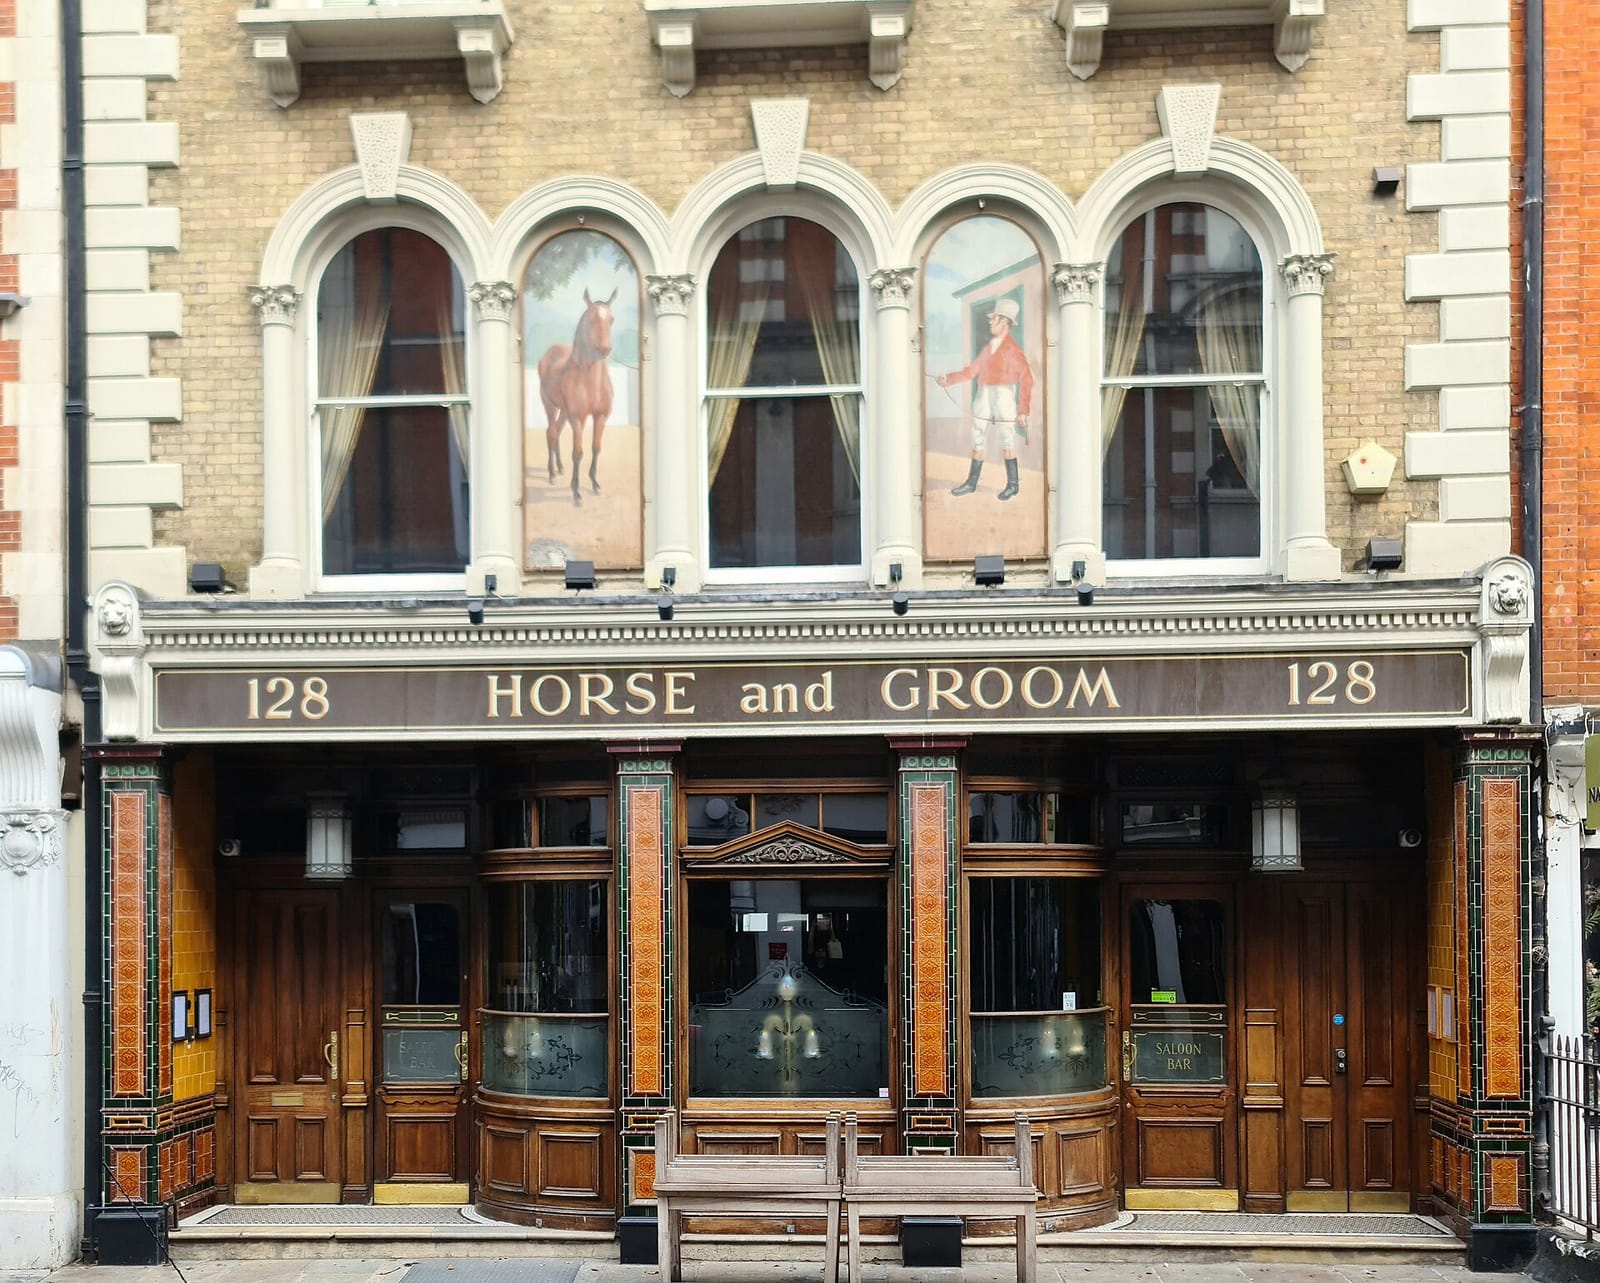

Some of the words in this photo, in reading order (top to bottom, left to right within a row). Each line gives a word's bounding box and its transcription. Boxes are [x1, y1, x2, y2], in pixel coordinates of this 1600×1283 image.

[247, 676, 330, 720] 128
[487, 672, 696, 718] HORSE
[740, 670, 836, 714] and
[880, 665, 1121, 712] GROOM
[1288, 660, 1377, 706] 128
[1156, 1042, 1202, 1056] SALOON
[1167, 1058, 1193, 1070] BAR
